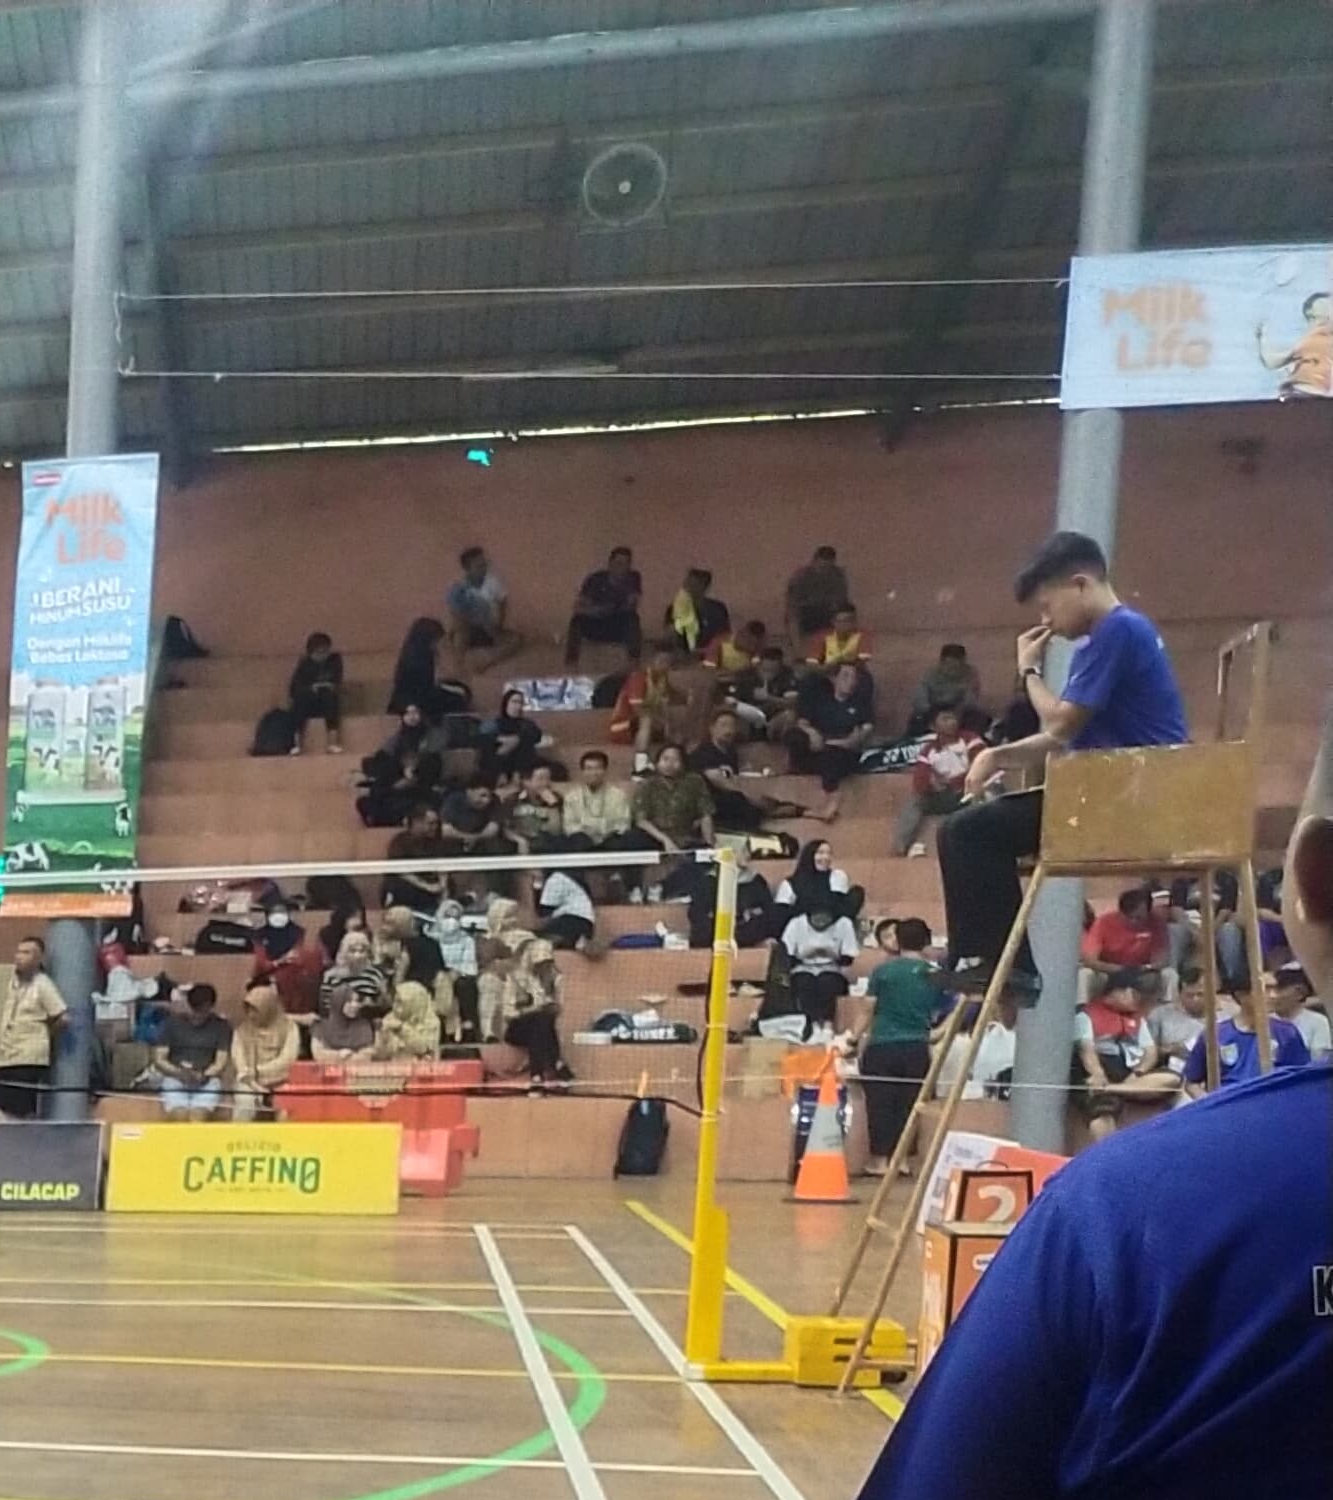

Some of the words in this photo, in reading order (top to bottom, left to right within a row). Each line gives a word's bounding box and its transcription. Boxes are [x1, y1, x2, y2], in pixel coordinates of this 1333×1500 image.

[1102, 277, 1208, 328] Milk
[1117, 328, 1213, 372] Life
[0, 1182, 81, 1201] CILACAP
